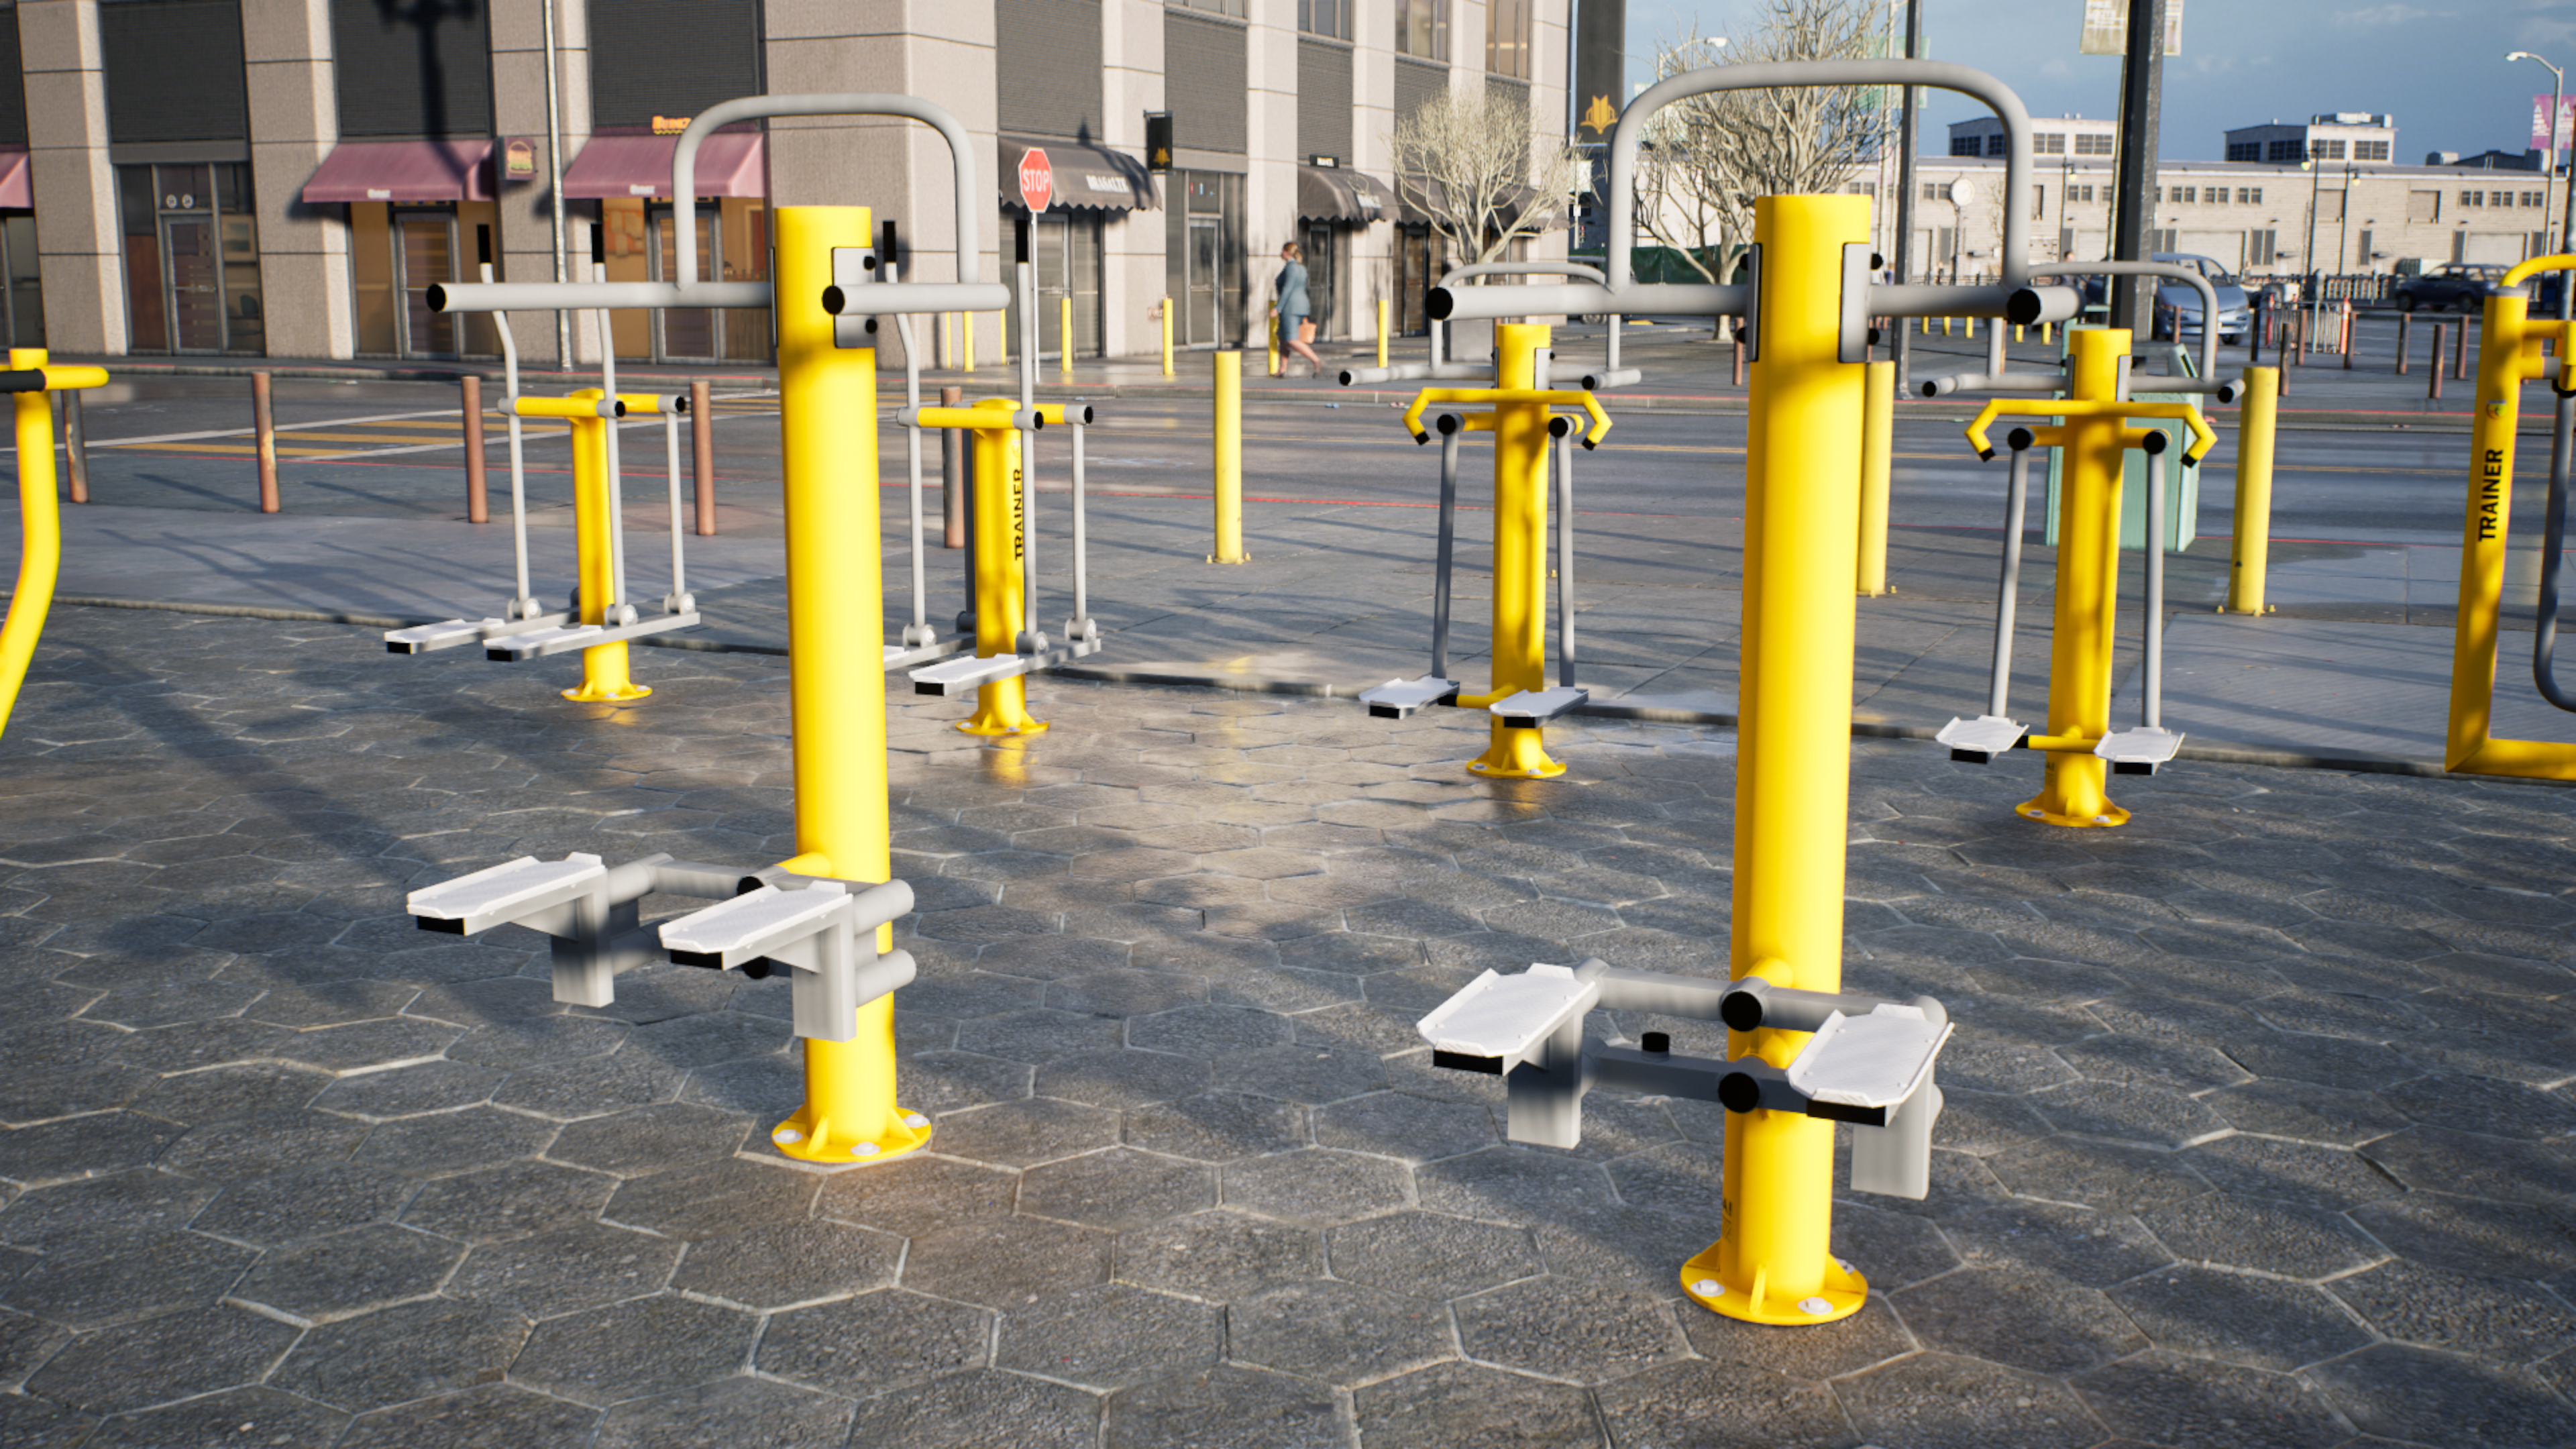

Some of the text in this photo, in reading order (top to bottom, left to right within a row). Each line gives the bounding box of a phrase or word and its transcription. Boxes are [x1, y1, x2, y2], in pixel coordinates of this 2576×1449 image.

[1022, 168, 1050, 193] STOP
[1013, 468, 1023, 561] TRAINER
[2477, 449, 2504, 542] TRAINER
